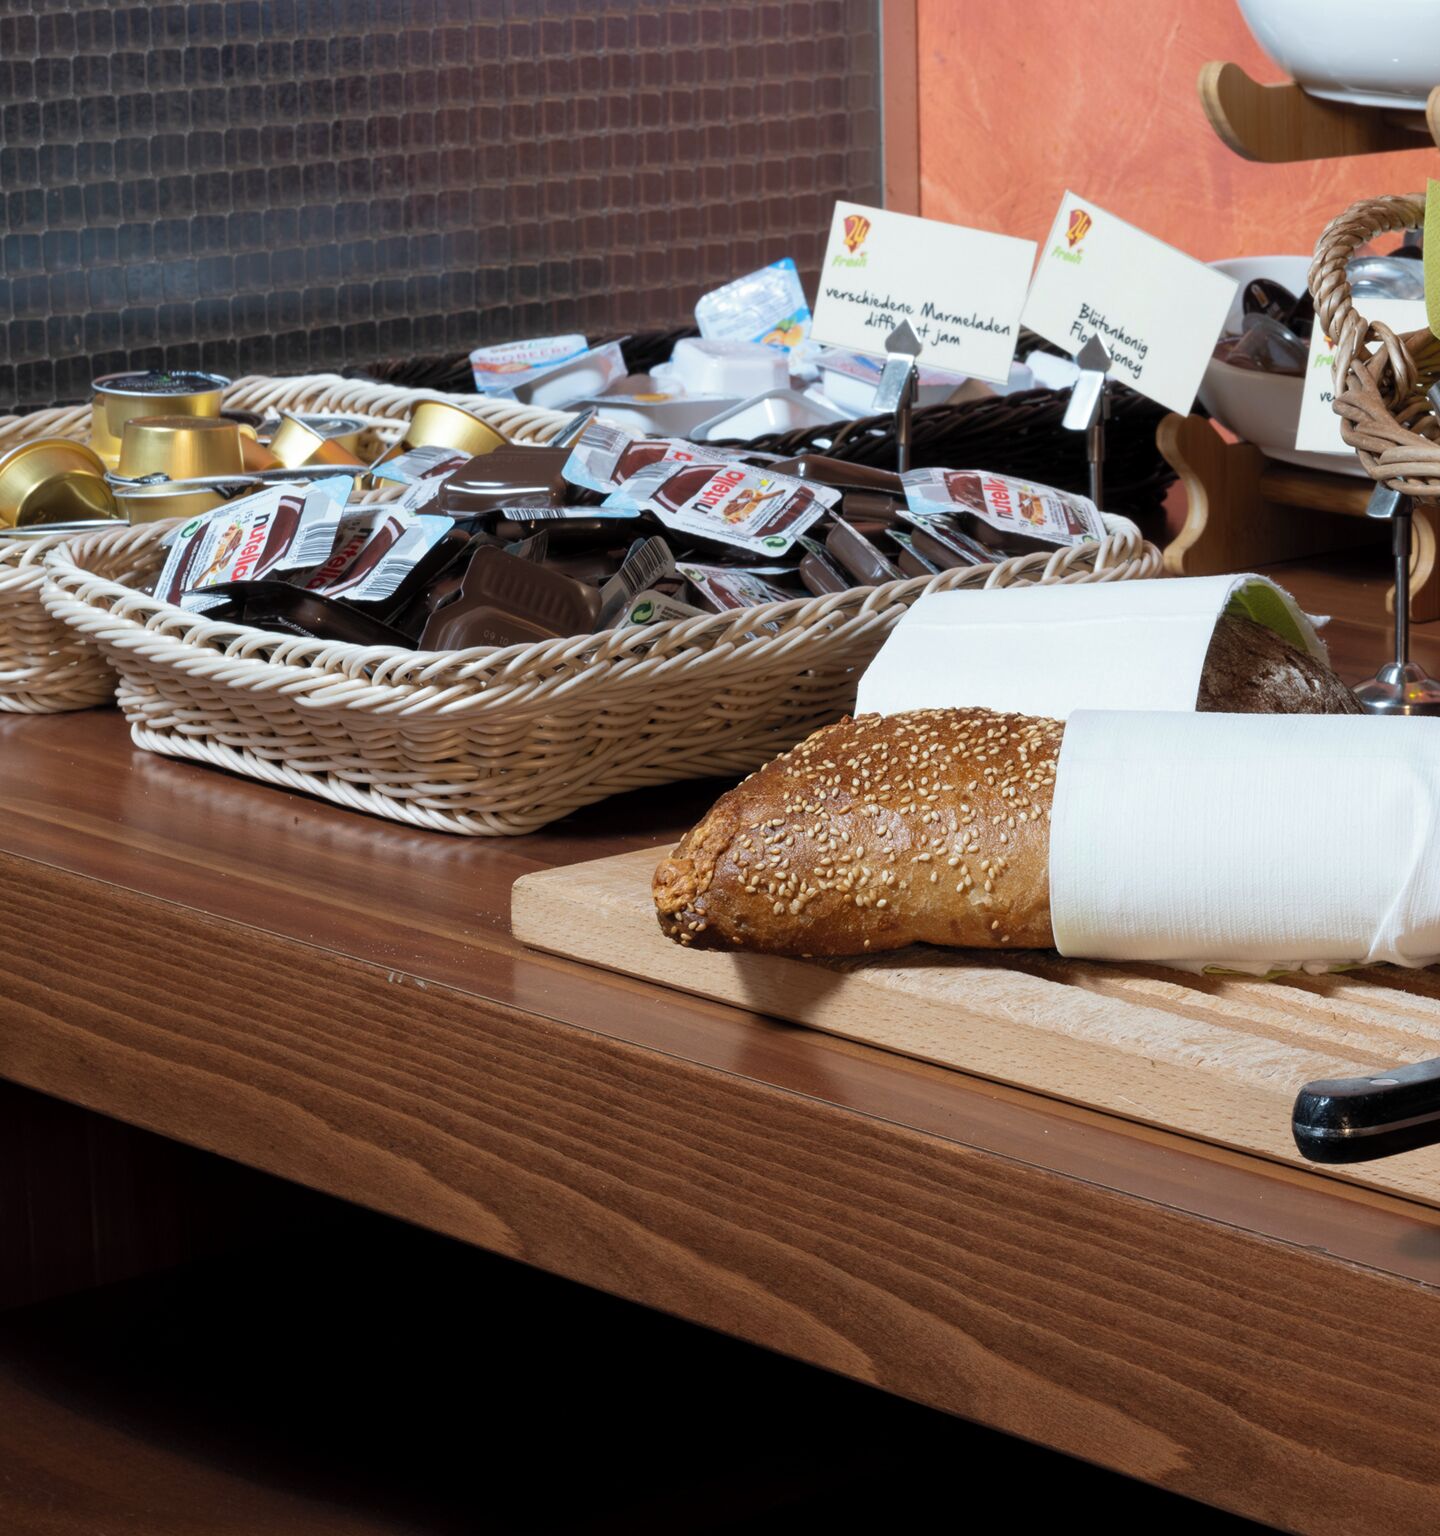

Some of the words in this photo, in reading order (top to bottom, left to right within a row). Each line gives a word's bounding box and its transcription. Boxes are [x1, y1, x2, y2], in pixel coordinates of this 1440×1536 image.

[843, 215, 868, 247] 24
[1065, 209, 1089, 240] 24
[825, 287, 915, 315] verschiedene
[920, 302, 1011, 336] Marmeladen
[864, 312, 931, 339] diffent
[931, 328, 961, 347] jam
[1078, 302, 1149, 361] Blütenhonig
[690, 469, 747, 514] nutella
[230, 513, 271, 581] nutella
[304, 527, 375, 590] nutella
